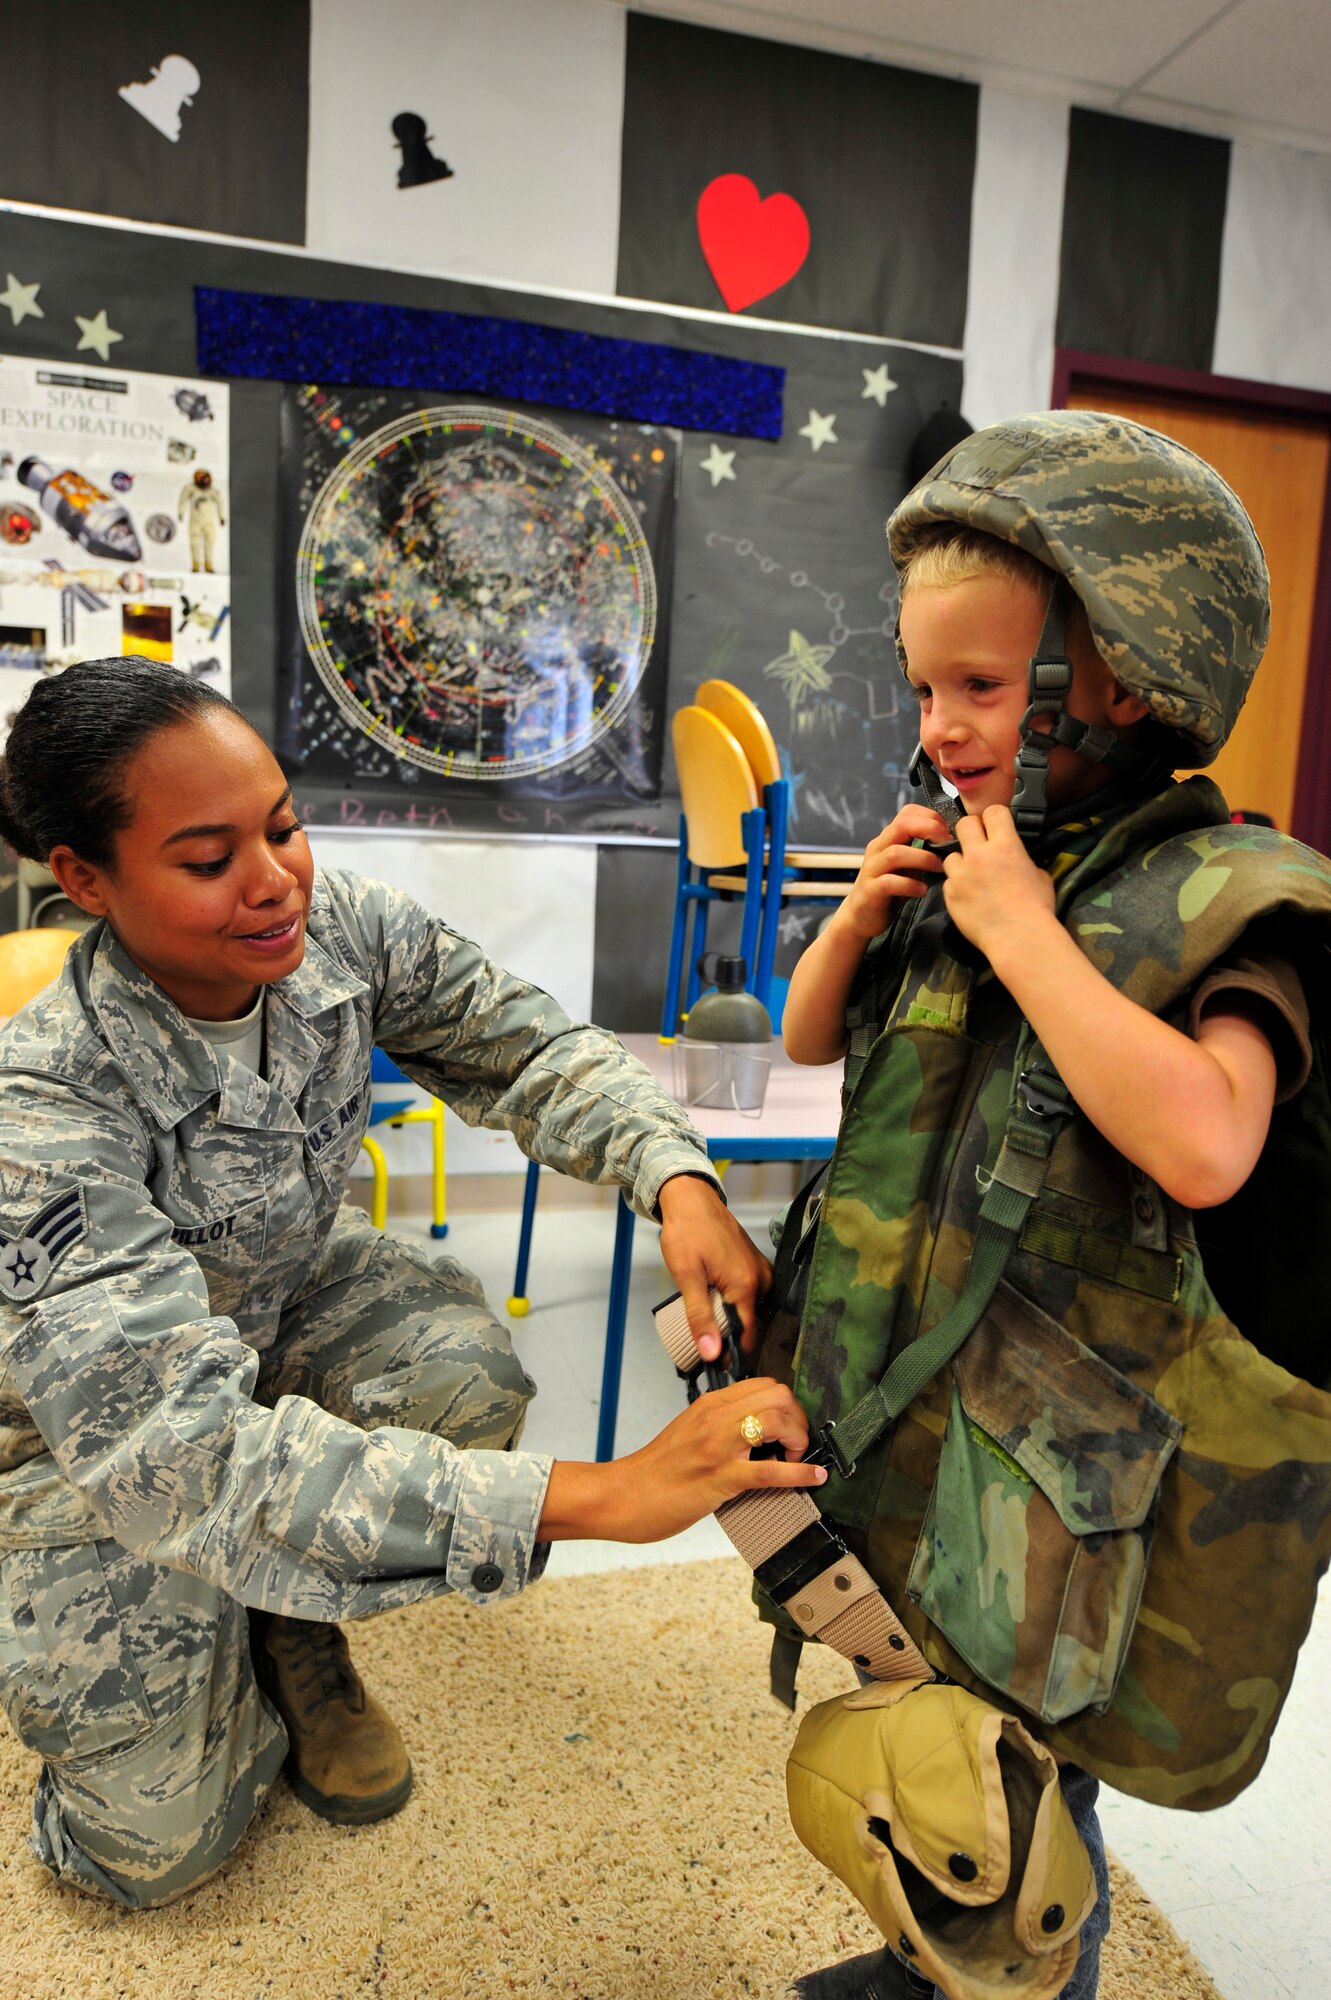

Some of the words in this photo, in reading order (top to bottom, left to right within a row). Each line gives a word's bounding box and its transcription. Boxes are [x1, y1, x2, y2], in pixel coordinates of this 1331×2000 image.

[47, 389, 118, 414] SPACE
[1, 407, 164, 441] EXPLORATION
[308, 1122, 337, 1152] U.S.
[339, 1095, 359, 1129] AIR
